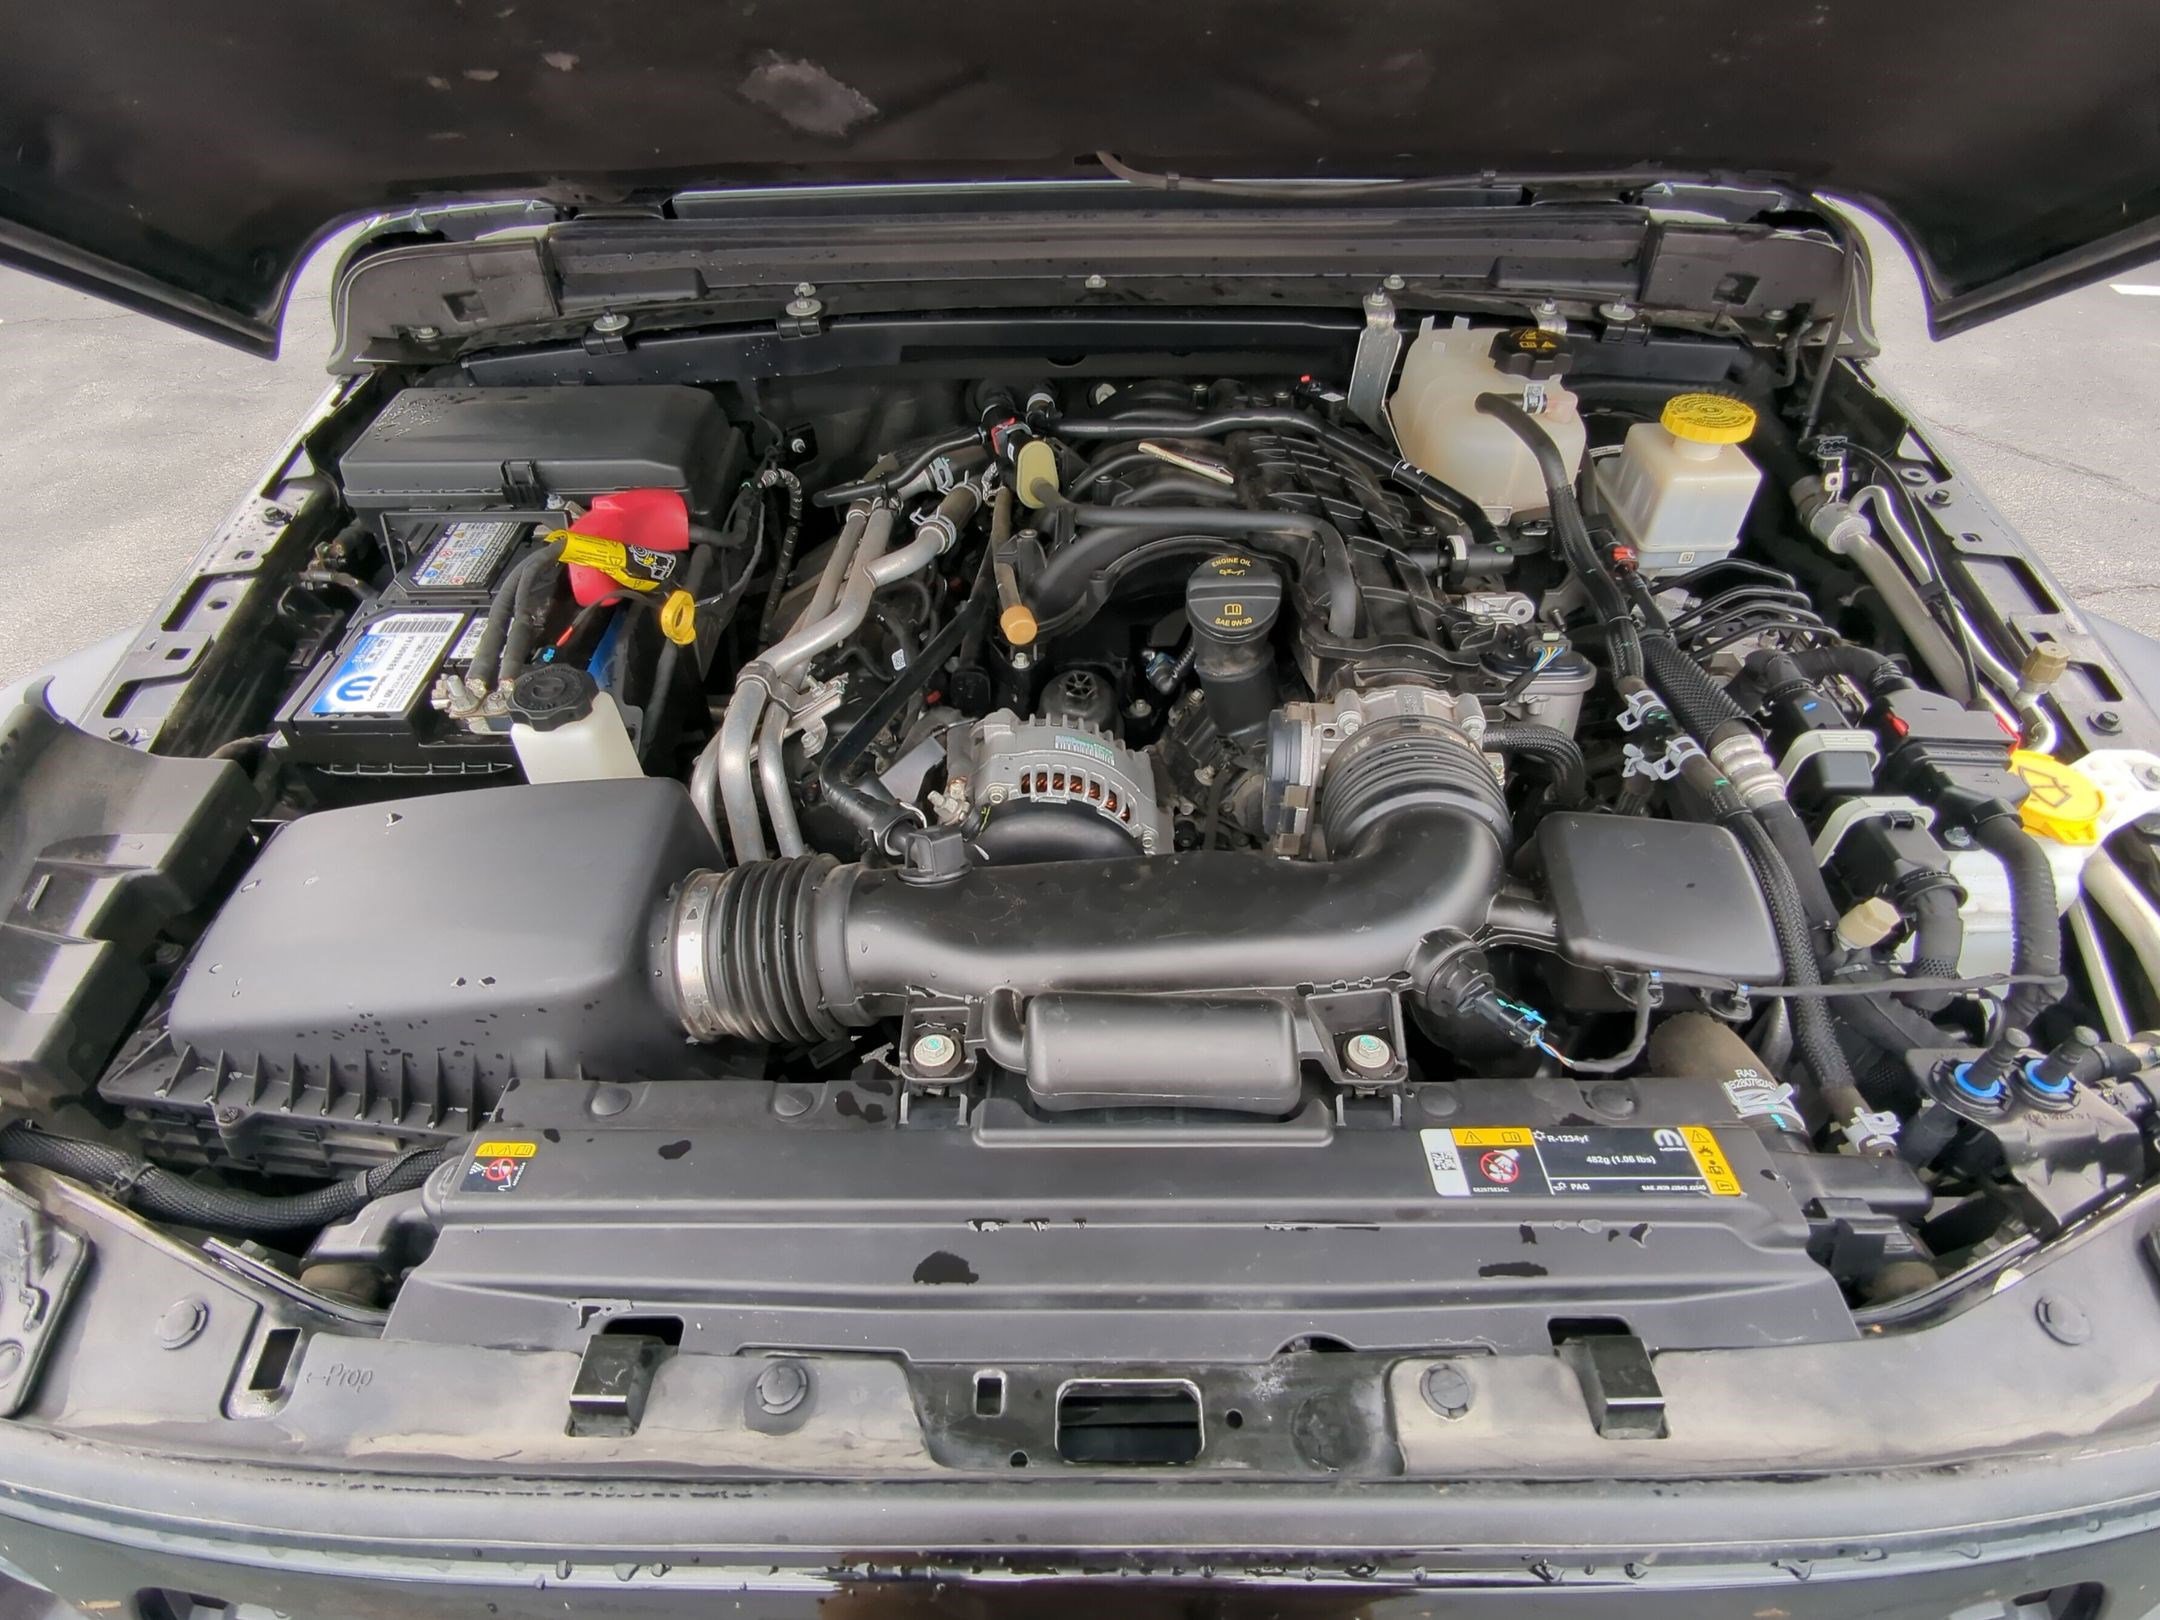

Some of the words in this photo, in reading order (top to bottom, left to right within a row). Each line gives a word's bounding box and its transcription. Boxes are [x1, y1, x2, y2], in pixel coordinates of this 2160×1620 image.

[1211, 557, 1239, 567] ENGINE
[1240, 558, 1252, 567] OIL
[1215, 617, 1230, 627] SAE
[1734, 1069, 1758, 1078] RAD
[1547, 1134, 1590, 1143] R-1234yf
[1636, 1155, 1657, 1165] lbs)
[1570, 1183, 1590, 1191] PAG
[325, 1362, 374, 1393] Prop
